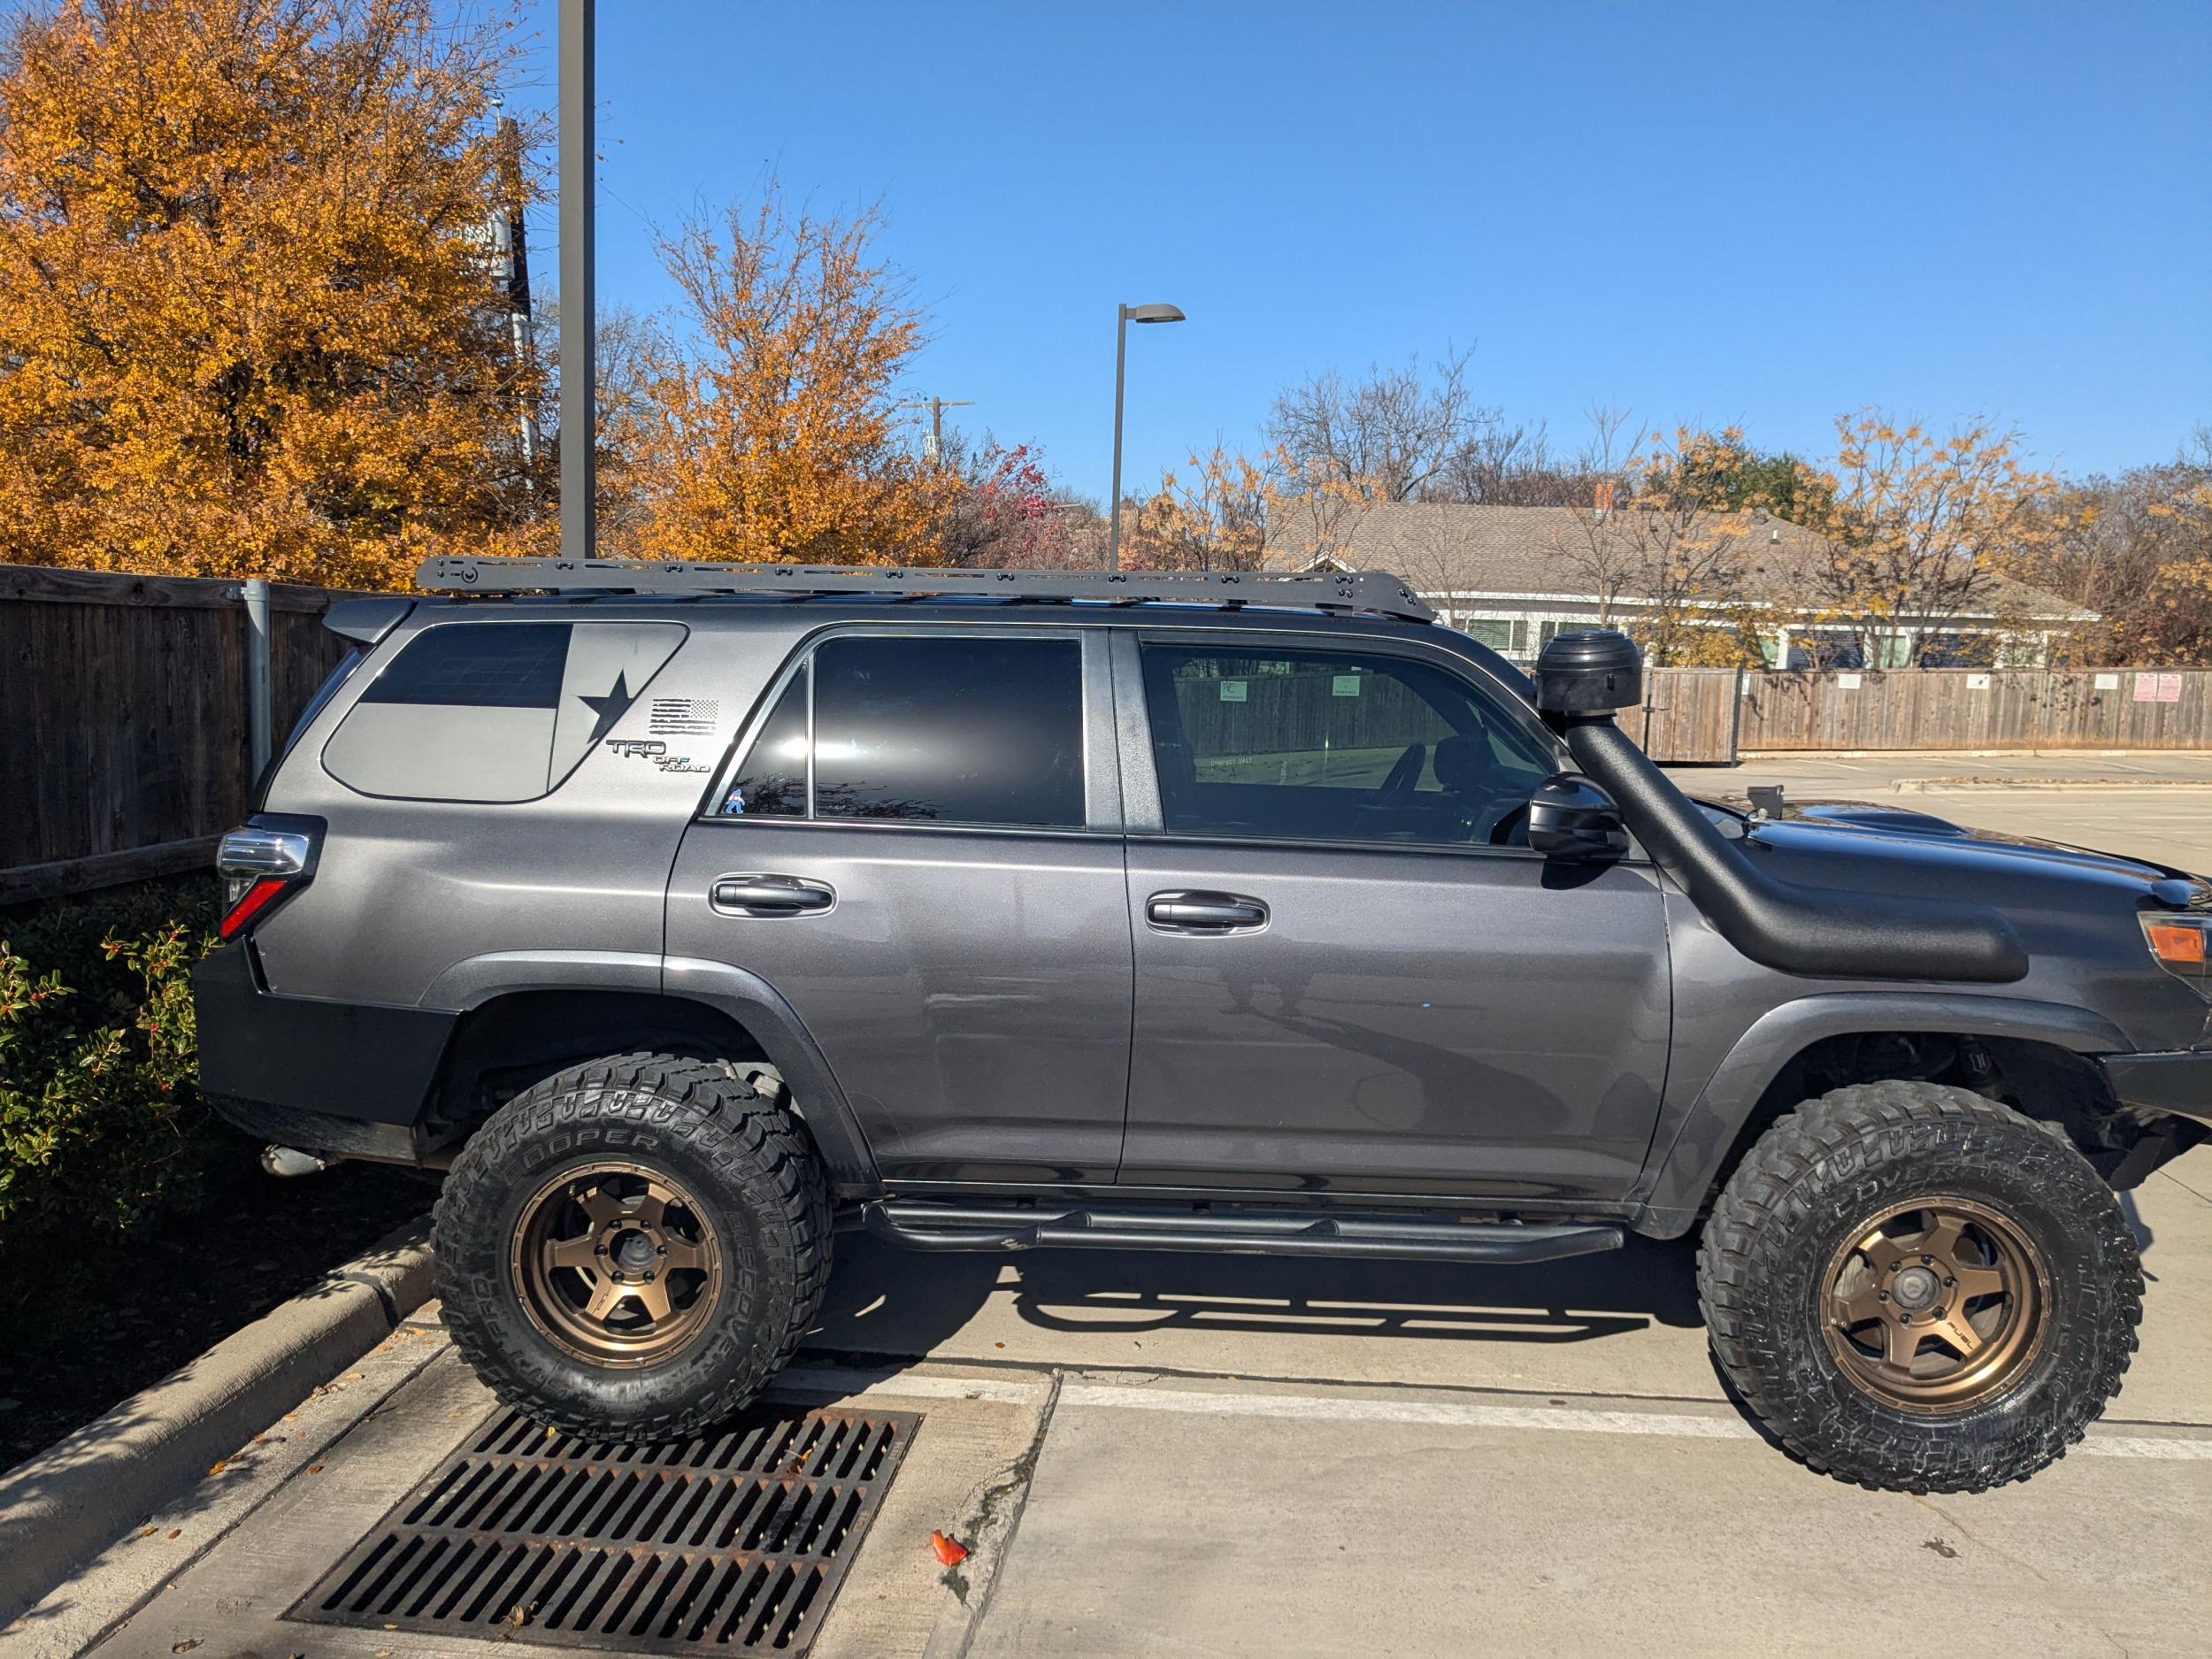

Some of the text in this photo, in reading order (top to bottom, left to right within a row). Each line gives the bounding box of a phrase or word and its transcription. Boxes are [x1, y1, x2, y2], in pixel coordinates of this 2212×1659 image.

[606, 740, 666, 758] TRD
[659, 764, 710, 772] ROAD
[502, 1128, 659, 1187] COOPER
[471, 1275, 510, 1340] PRO
[1947, 1322, 1973, 1350] FUEL
